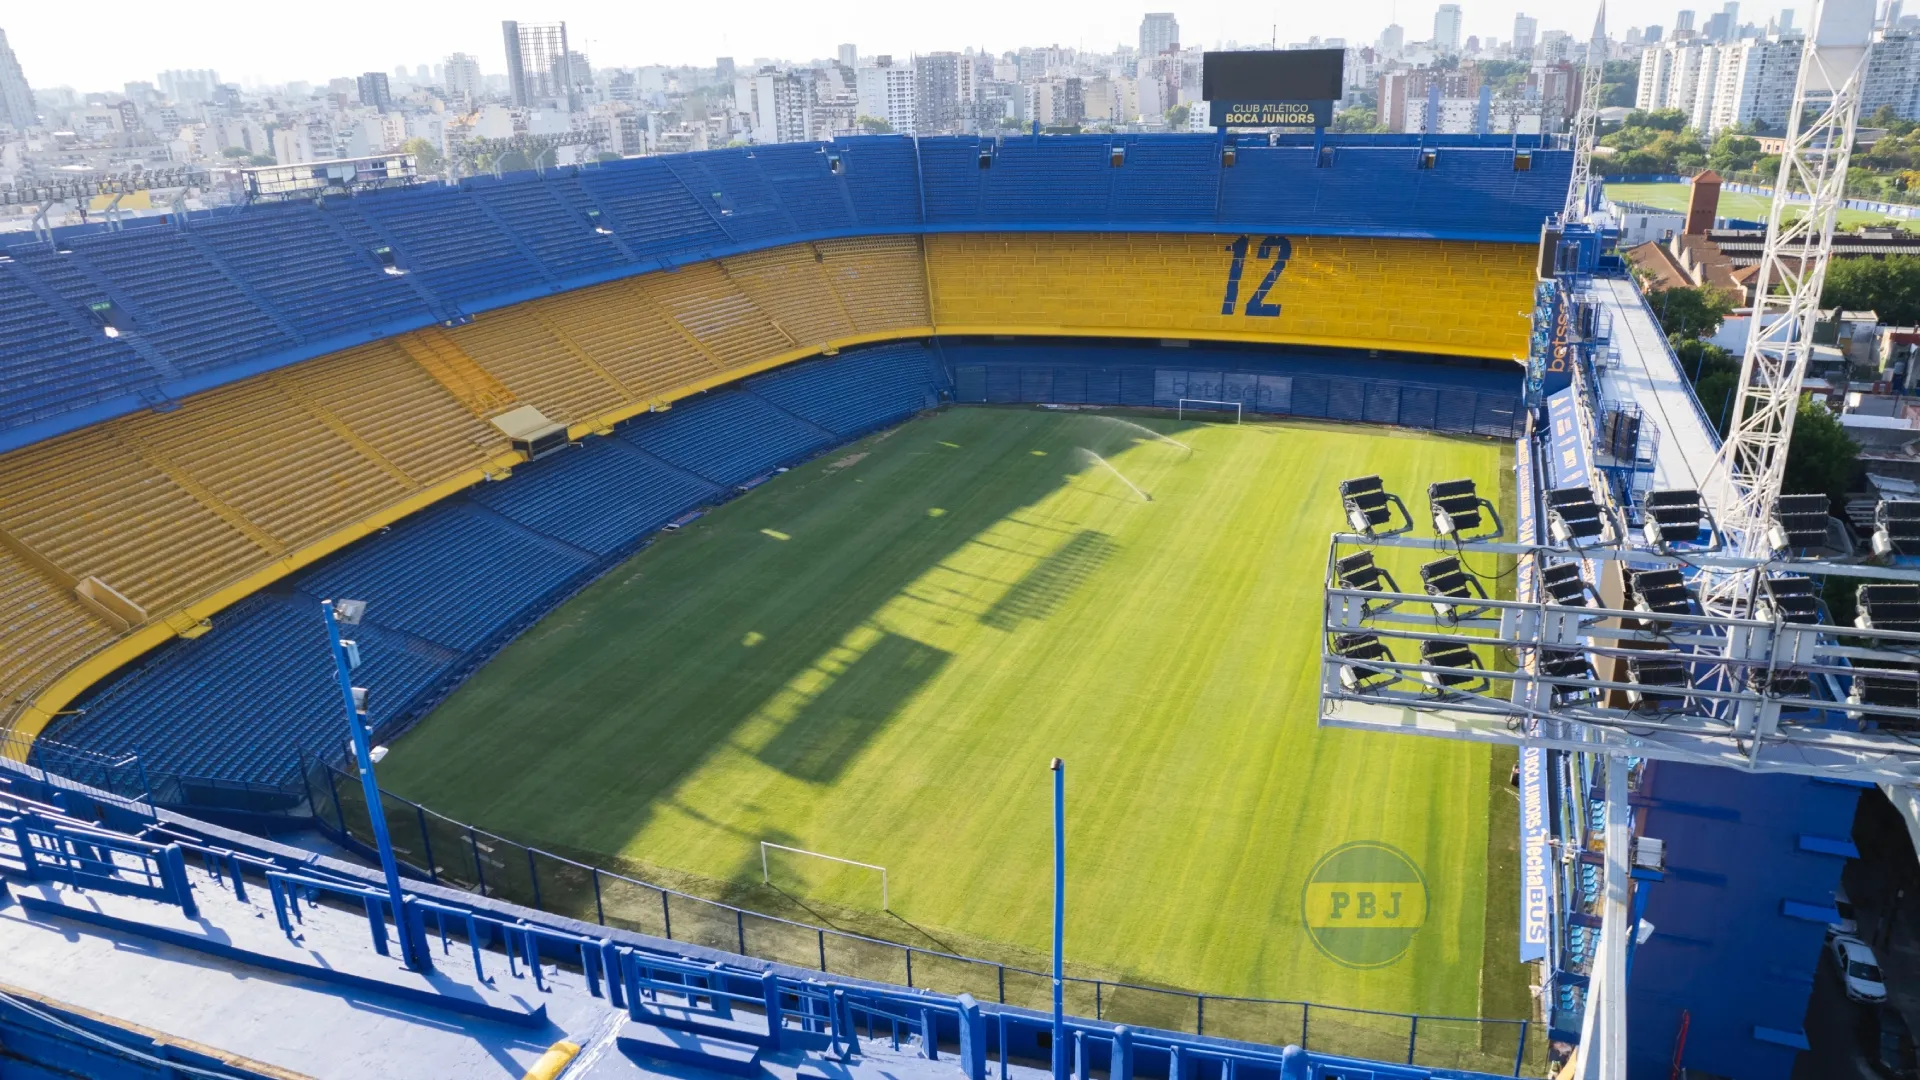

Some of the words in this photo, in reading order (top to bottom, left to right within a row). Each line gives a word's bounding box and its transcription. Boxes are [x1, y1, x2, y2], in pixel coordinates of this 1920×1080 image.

[1225, 113, 1259, 123] BOCA
[1261, 113, 1315, 123] JUNIORS
[1233, 104, 1260, 113] CLUB
[1262, 102, 1309, 113] ATLÉTICO
[1221, 234, 1292, 316] 12
[1524, 756, 1541, 786] BOCA
[1525, 784, 1542, 829] JUNIORS
